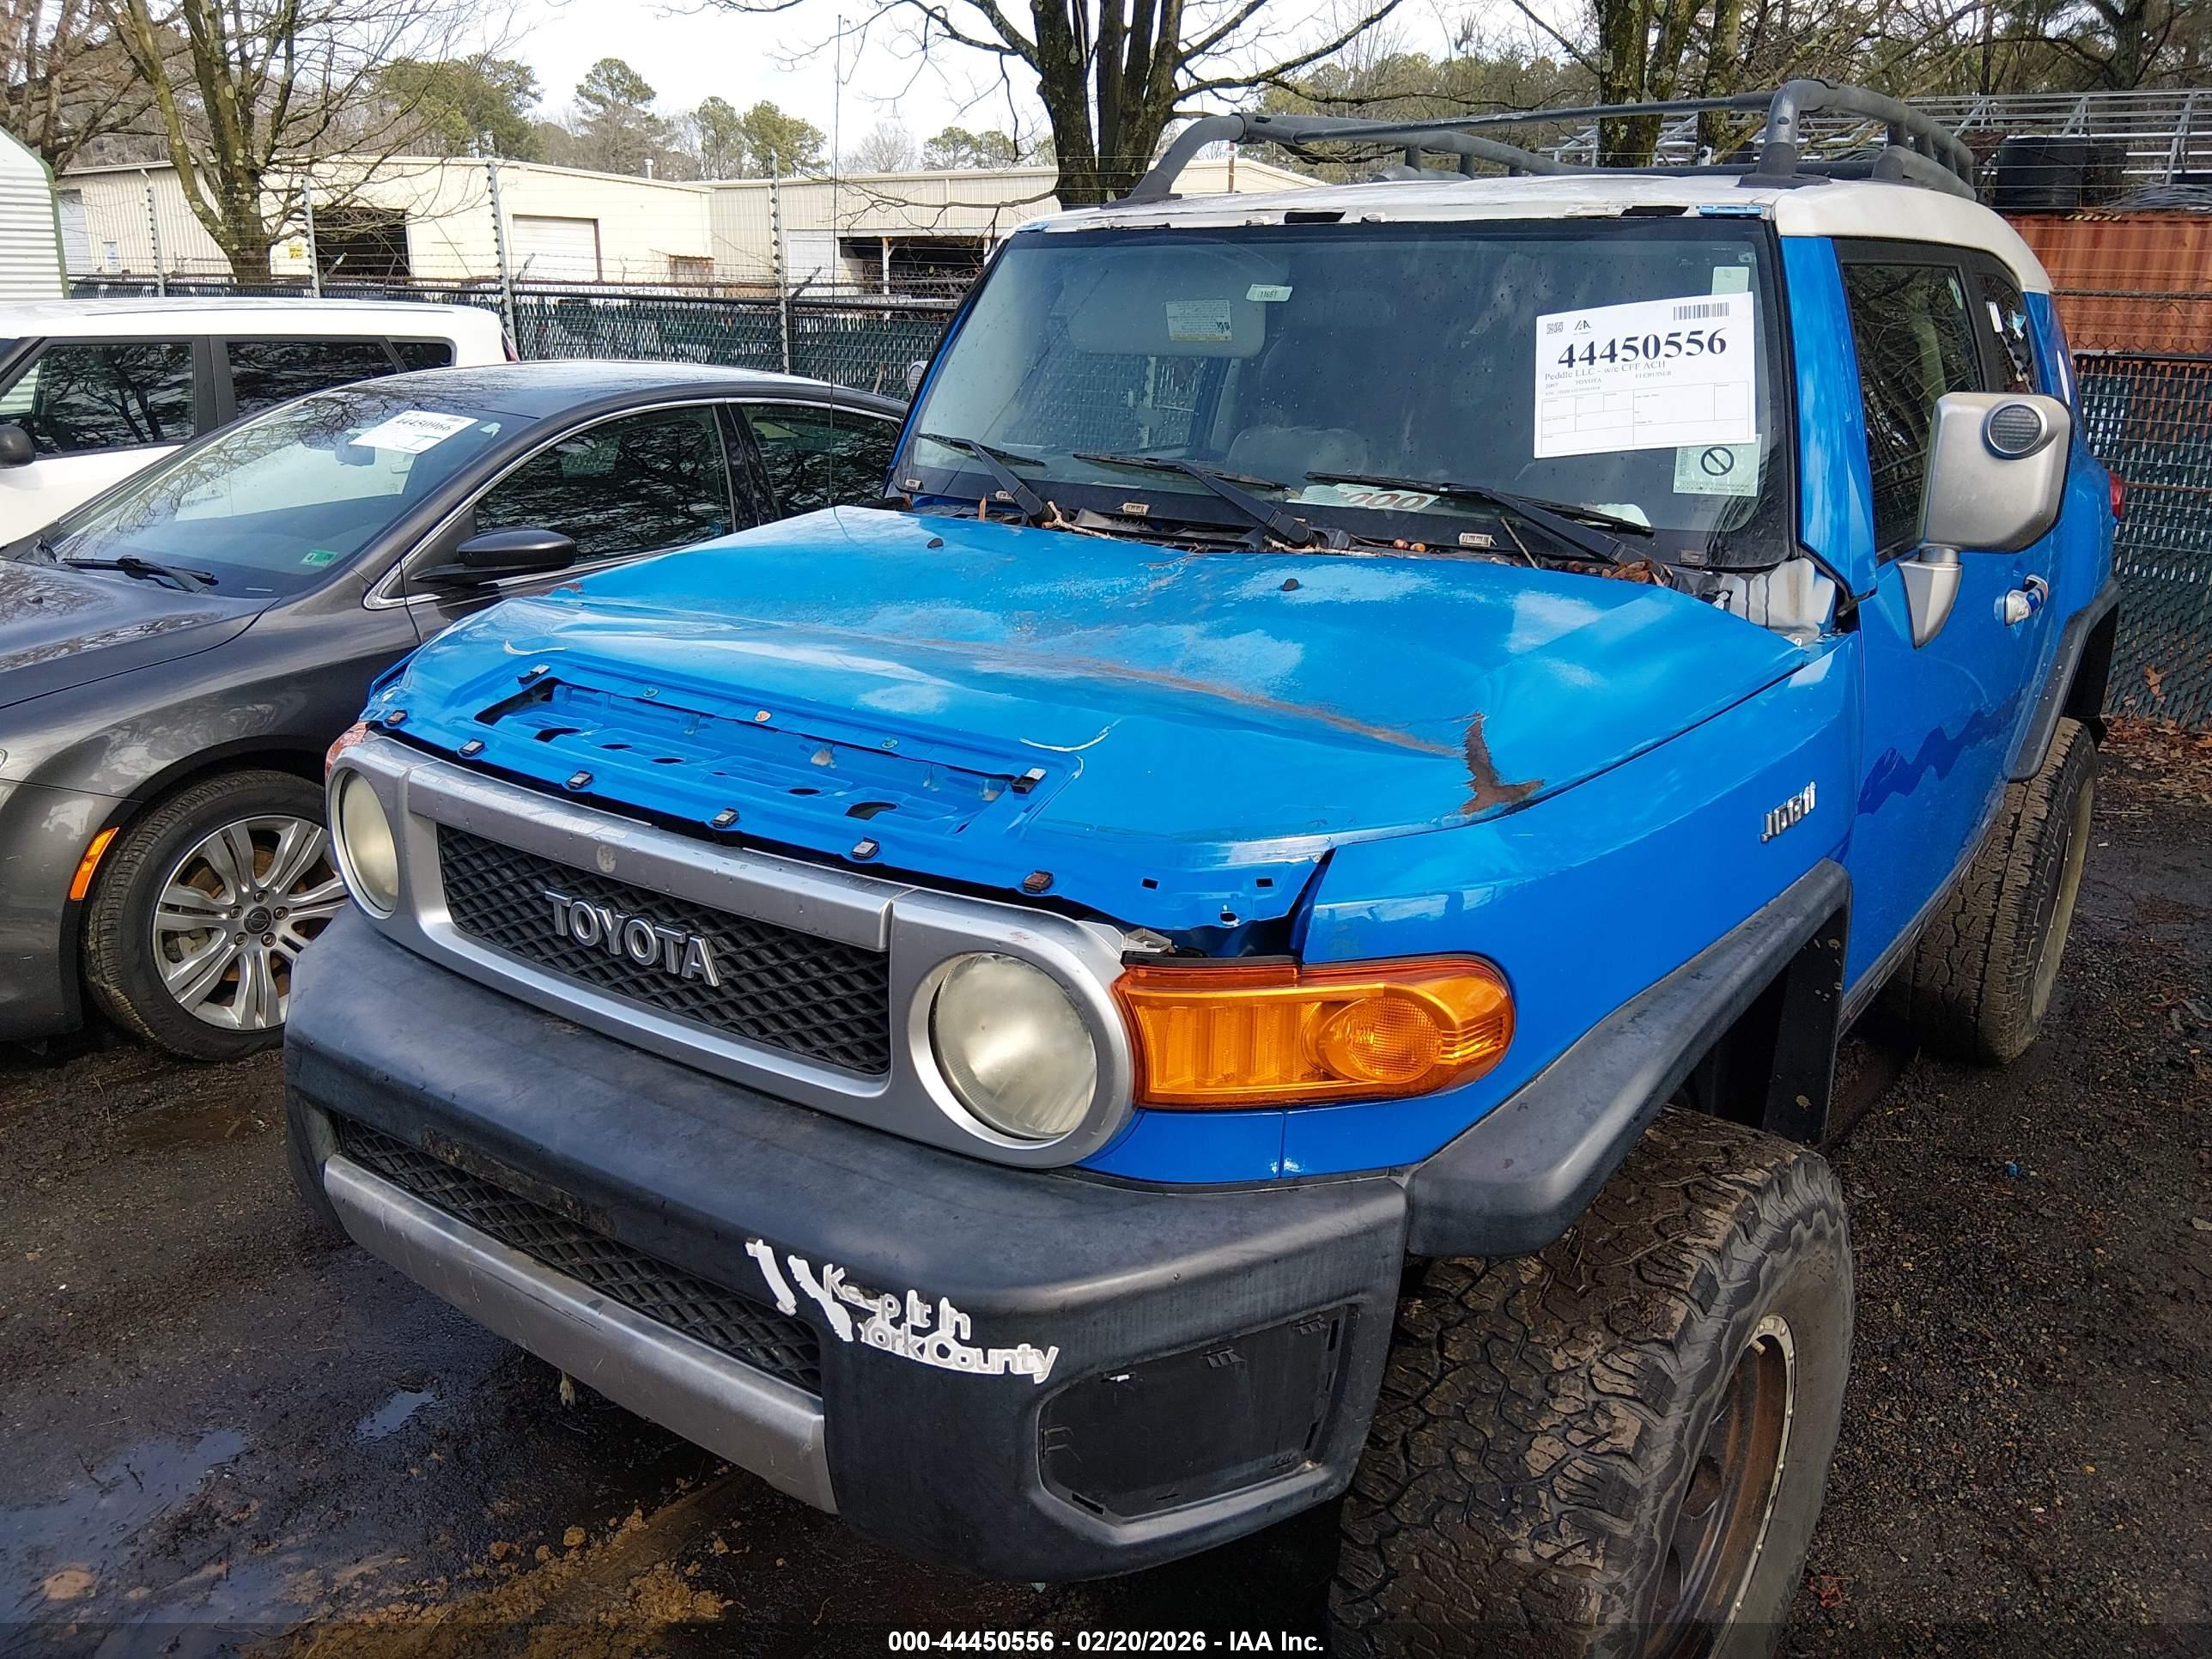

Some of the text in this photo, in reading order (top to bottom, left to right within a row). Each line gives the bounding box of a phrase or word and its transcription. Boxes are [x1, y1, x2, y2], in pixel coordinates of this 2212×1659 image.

[1545, 370, 1572, 380] Peddle
[1575, 368, 1595, 377] LLC
[1557, 327, 1727, 368] 44450556
[544, 886, 722, 988] TOYOTA
[858, 1316, 1059, 1384] York County
